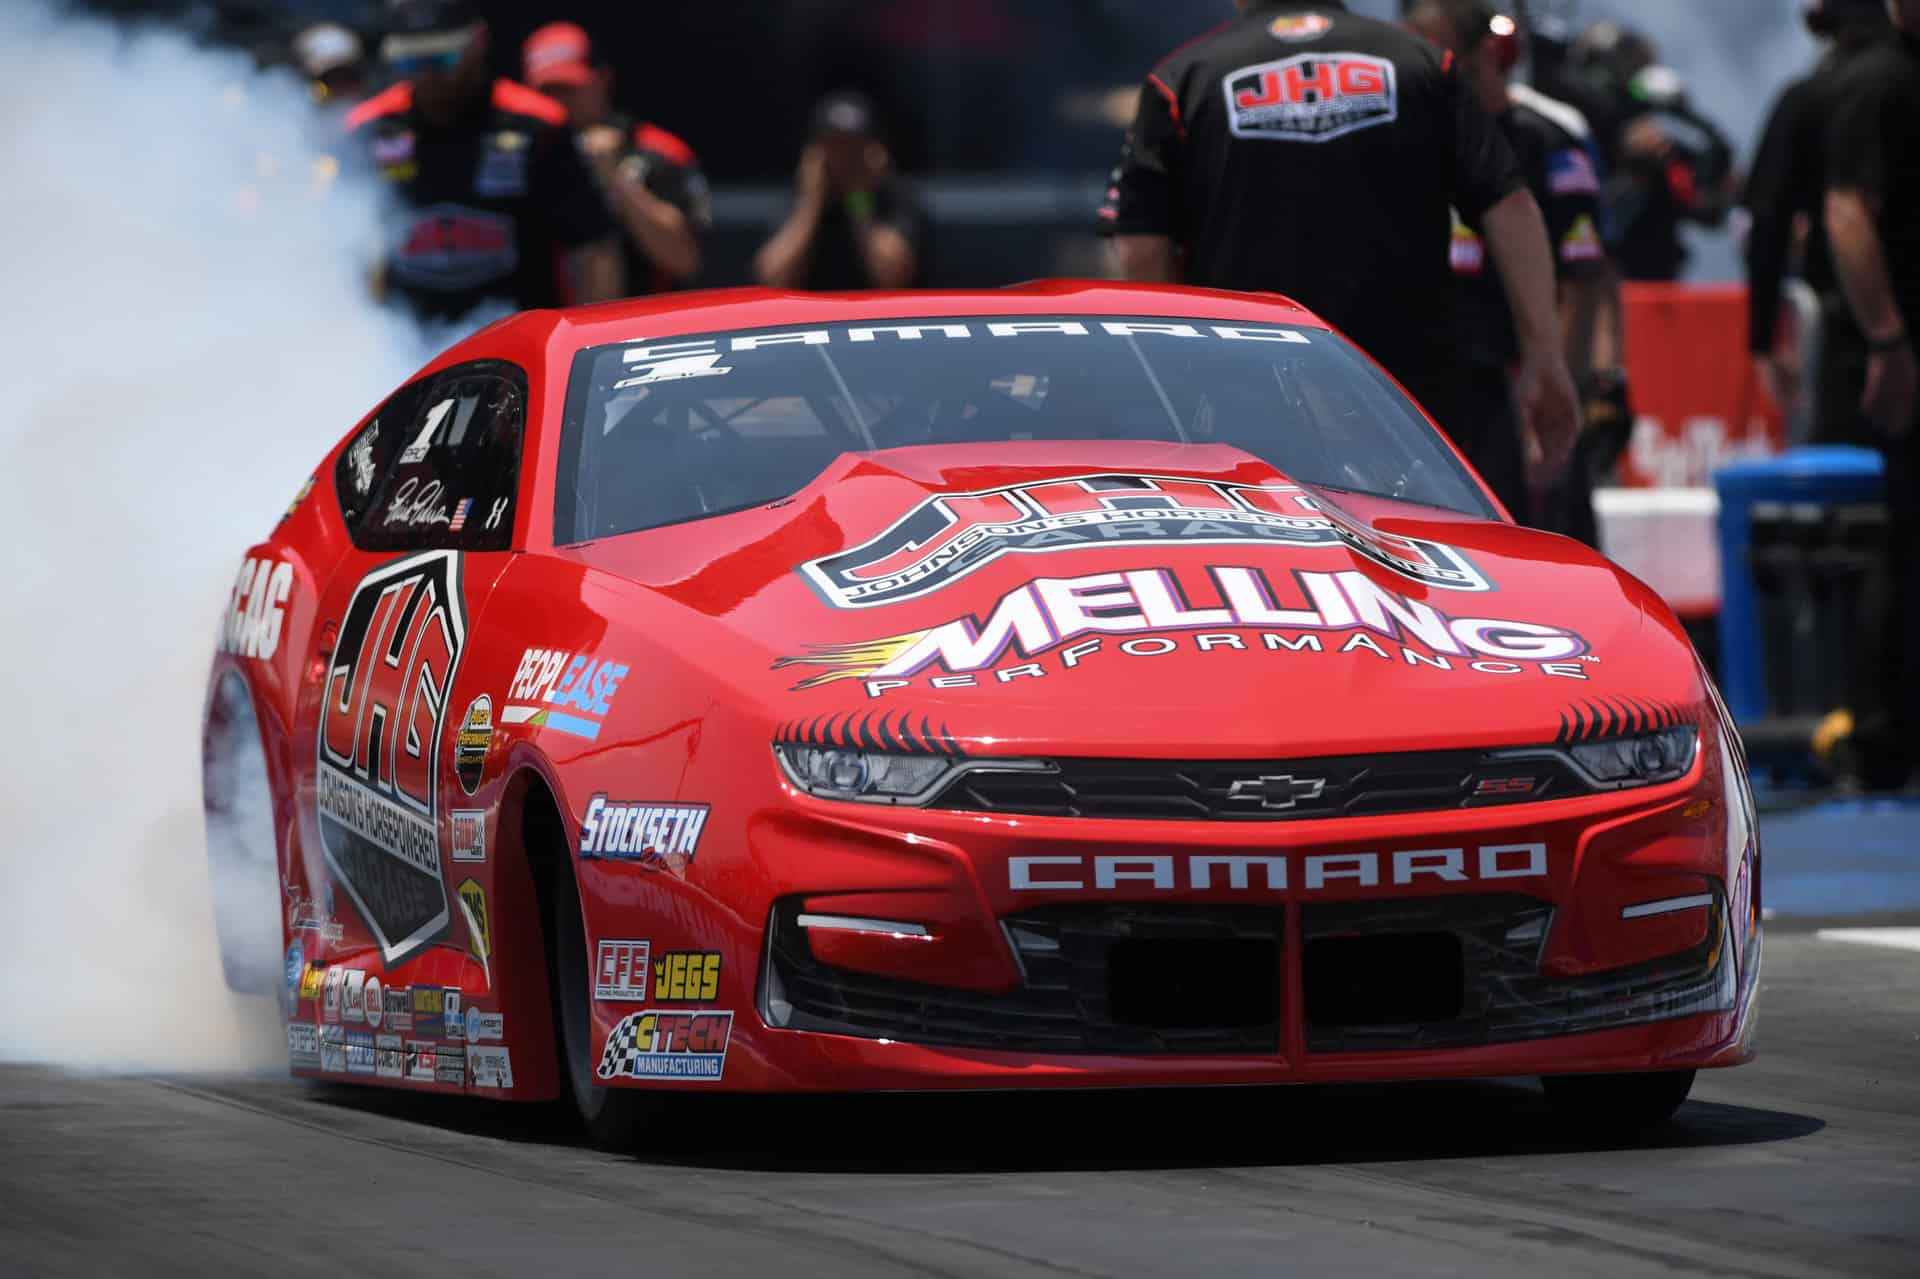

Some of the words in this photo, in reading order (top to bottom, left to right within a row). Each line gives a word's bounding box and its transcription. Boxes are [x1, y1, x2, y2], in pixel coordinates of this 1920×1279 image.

[1236, 60, 1384, 108] JHG
[622, 319, 1312, 363] CAMARO
[399, 399, 455, 464] 1
[848, 511, 1086, 598] JOHNSON'S
[868, 566, 1592, 679] MELLING
[866, 630, 1590, 698] PERFORMANCE
[325, 572, 456, 806] JHG
[1478, 778, 1533, 794] SS
[581, 797, 707, 857] STOCKSETH
[1008, 842, 1547, 890] CAMARO
[598, 947, 647, 985] CFE
[654, 954, 720, 1000] JEGS
[637, 1057, 718, 1076] MANUFACTURING
